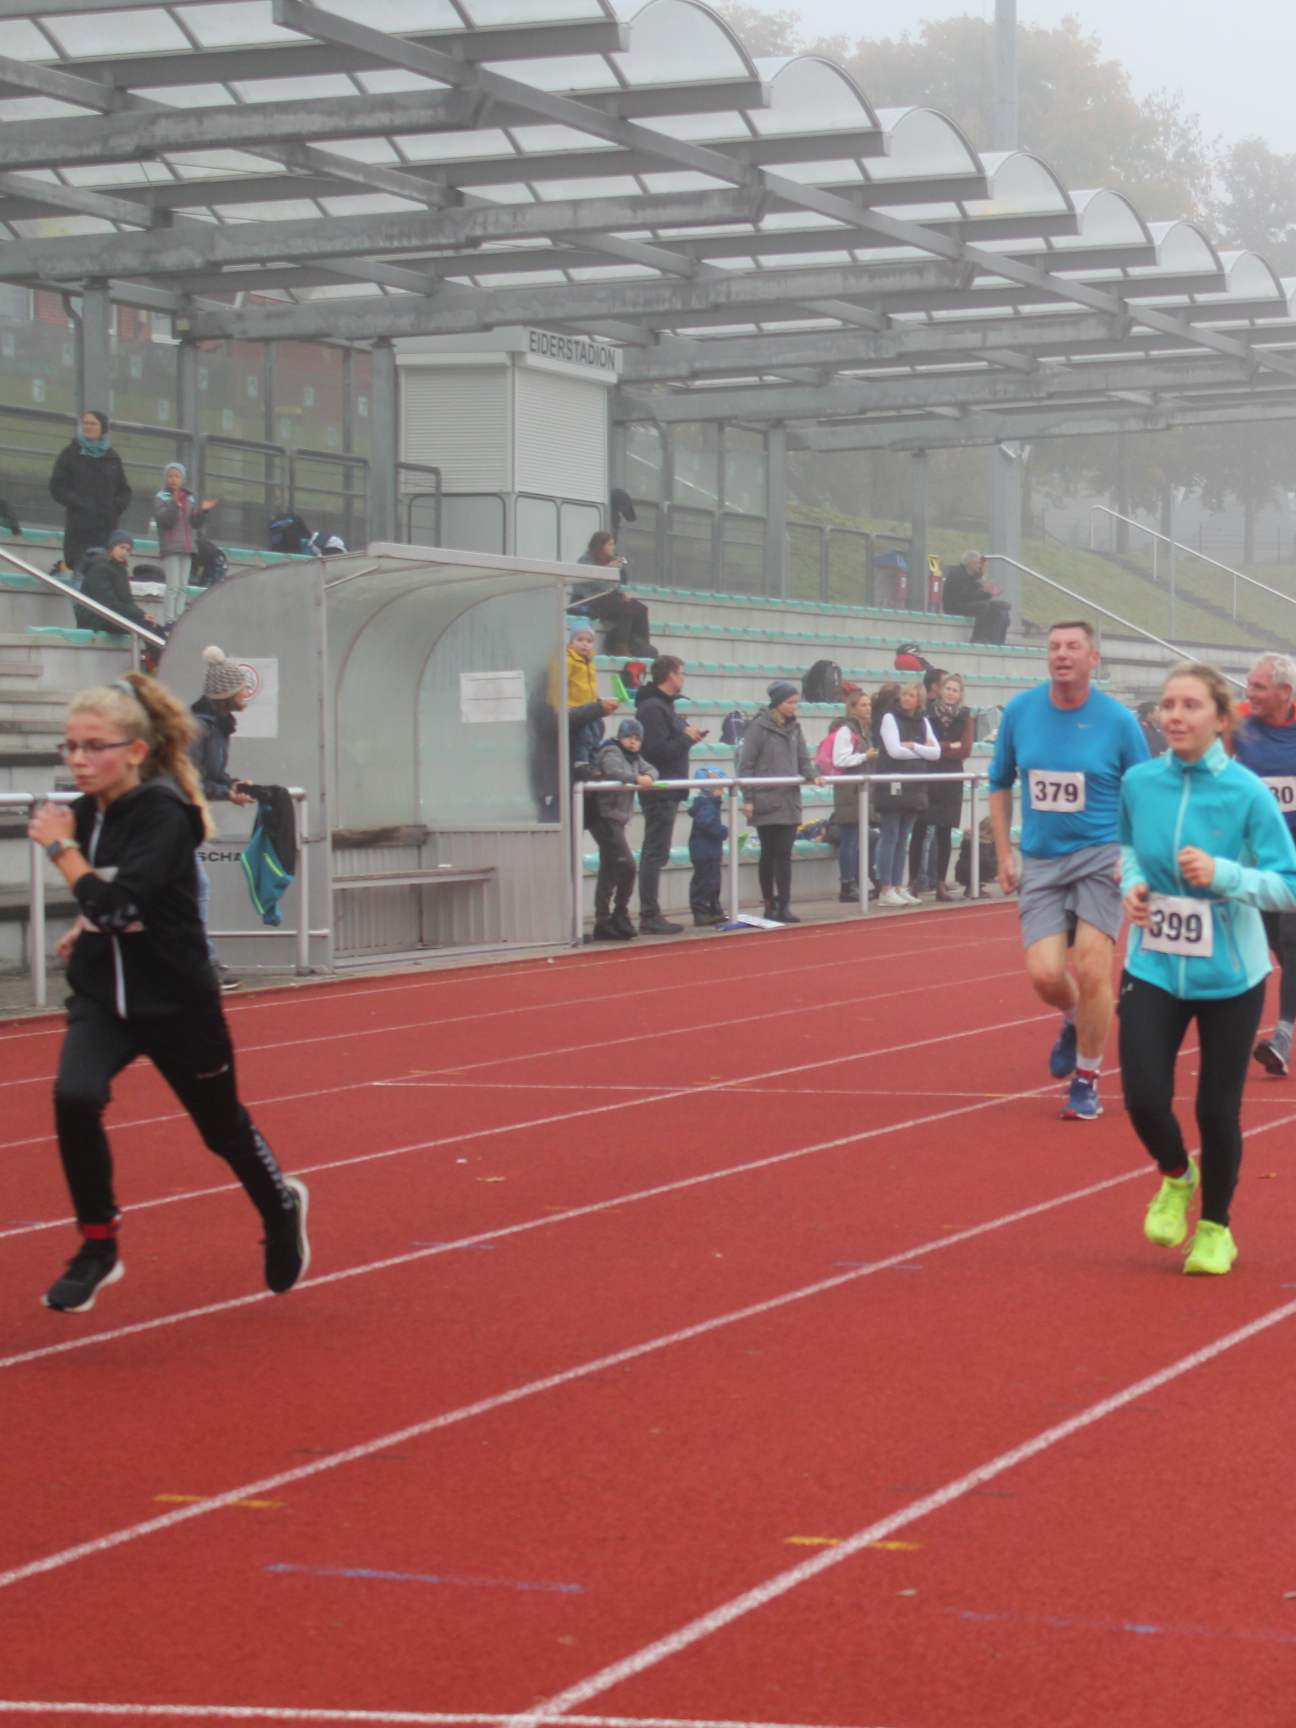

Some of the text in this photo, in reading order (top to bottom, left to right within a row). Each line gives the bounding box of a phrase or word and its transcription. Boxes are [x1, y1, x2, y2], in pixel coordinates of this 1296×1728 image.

[529, 330, 616, 371] EIDERSTADION
[1035, 780, 1078, 803] 379
[1149, 909, 1202, 943] 399
